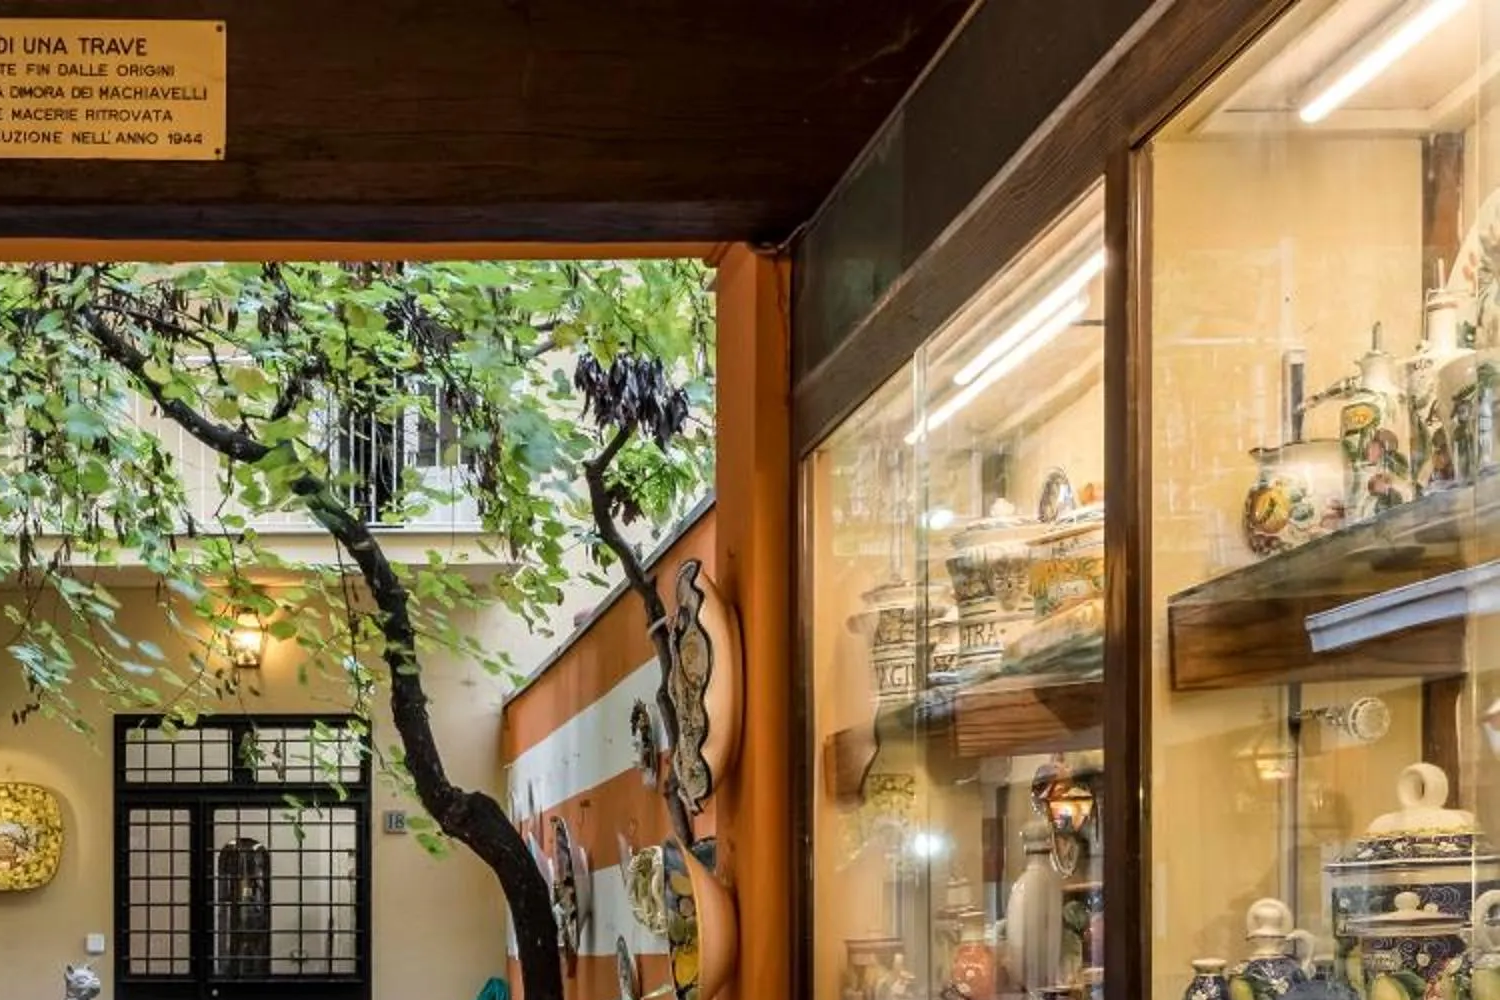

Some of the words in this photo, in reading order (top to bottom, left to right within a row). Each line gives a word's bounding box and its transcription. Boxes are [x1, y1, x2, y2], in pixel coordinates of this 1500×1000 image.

[23, 36, 68, 55] UNA
[78, 36, 148, 56] TRAVE
[26, 63, 51, 76] FIN
[57, 63, 109, 77] DALLE
[116, 64, 175, 77] ORIGINI
[9, 86, 65, 99] DIMORA
[71, 86, 93, 99] DEI
[99, 86, 208, 101] MACHIAVELLI
[11, 108, 78, 121] MACERIE
[85, 109, 173, 122] RITROVATA
[167, 132, 205, 145] 1944
[388, 814, 405, 828] 18
